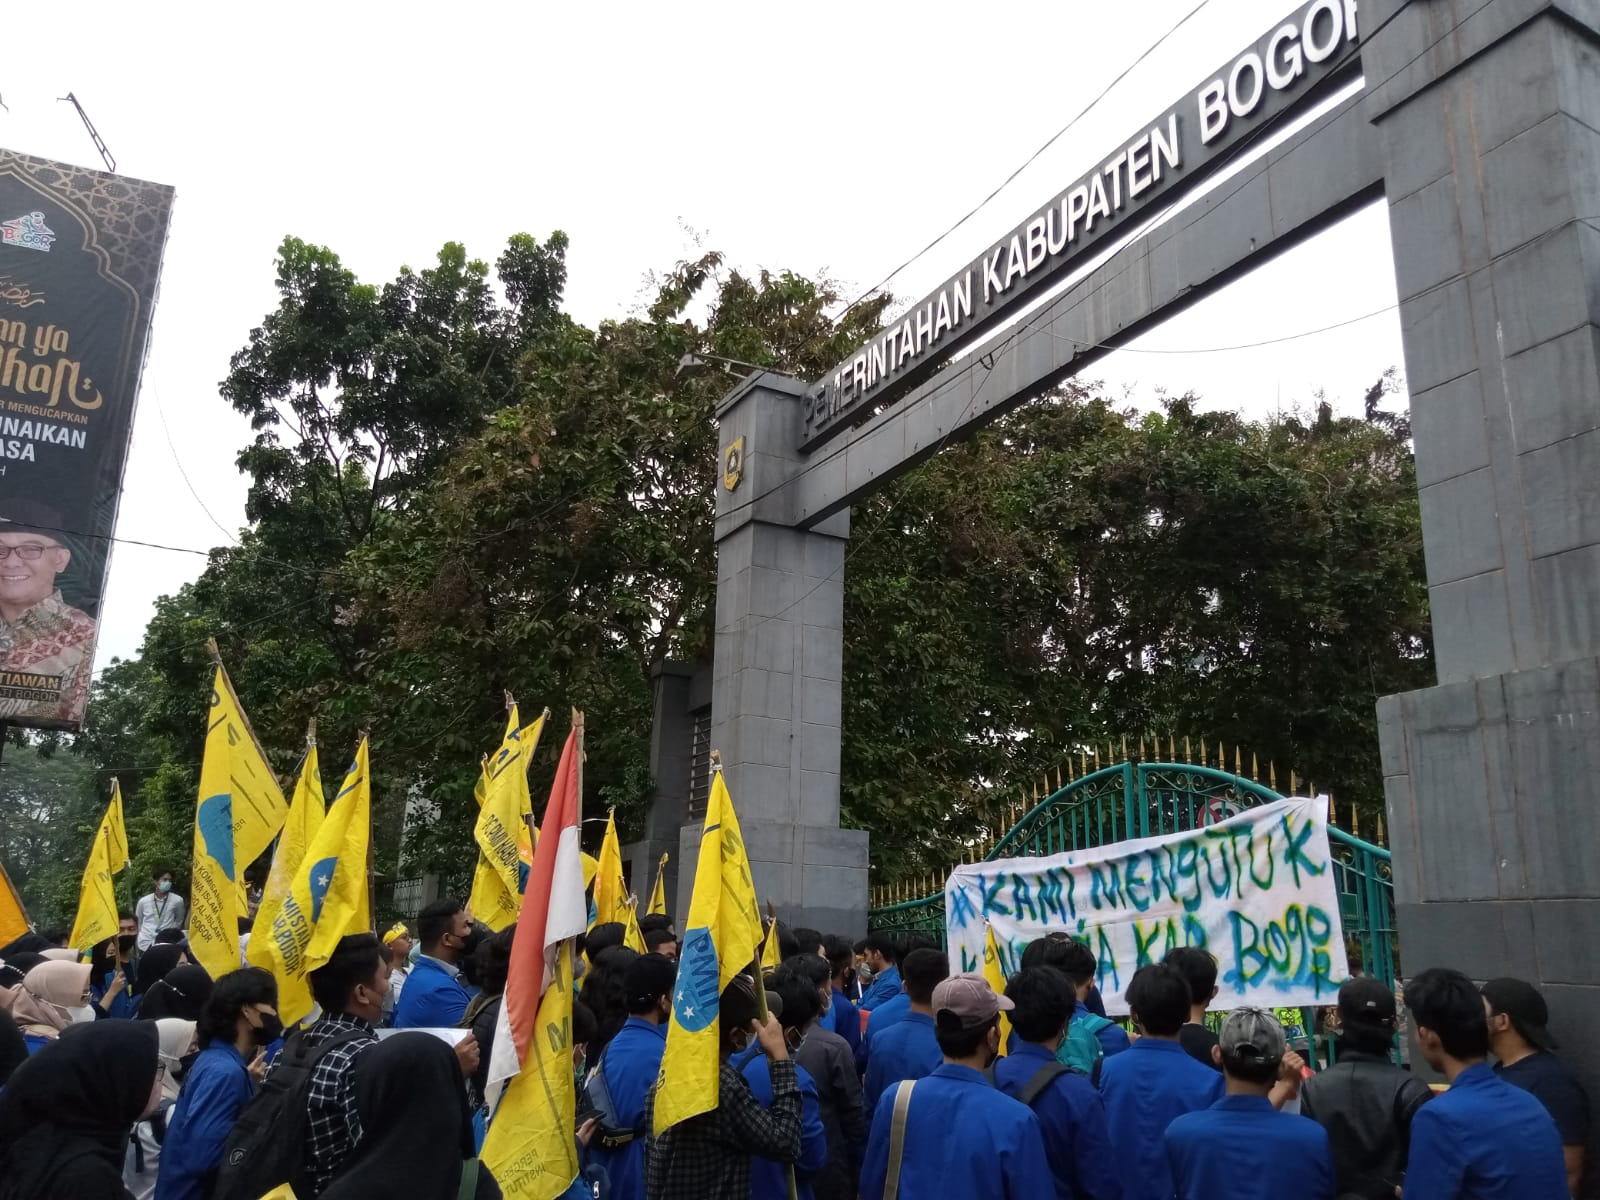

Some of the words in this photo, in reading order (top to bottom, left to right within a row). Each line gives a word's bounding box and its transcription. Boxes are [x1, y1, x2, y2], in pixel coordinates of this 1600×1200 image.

[804, 270, 974, 427] PEMERINTAHAN
[981, 114, 1181, 304] KABUPATEN
[8, 401, 88, 425] MENGUCAPKAN
[0, 416, 87, 449] NAIKAN
[192, 916, 212, 943] BOGOR
